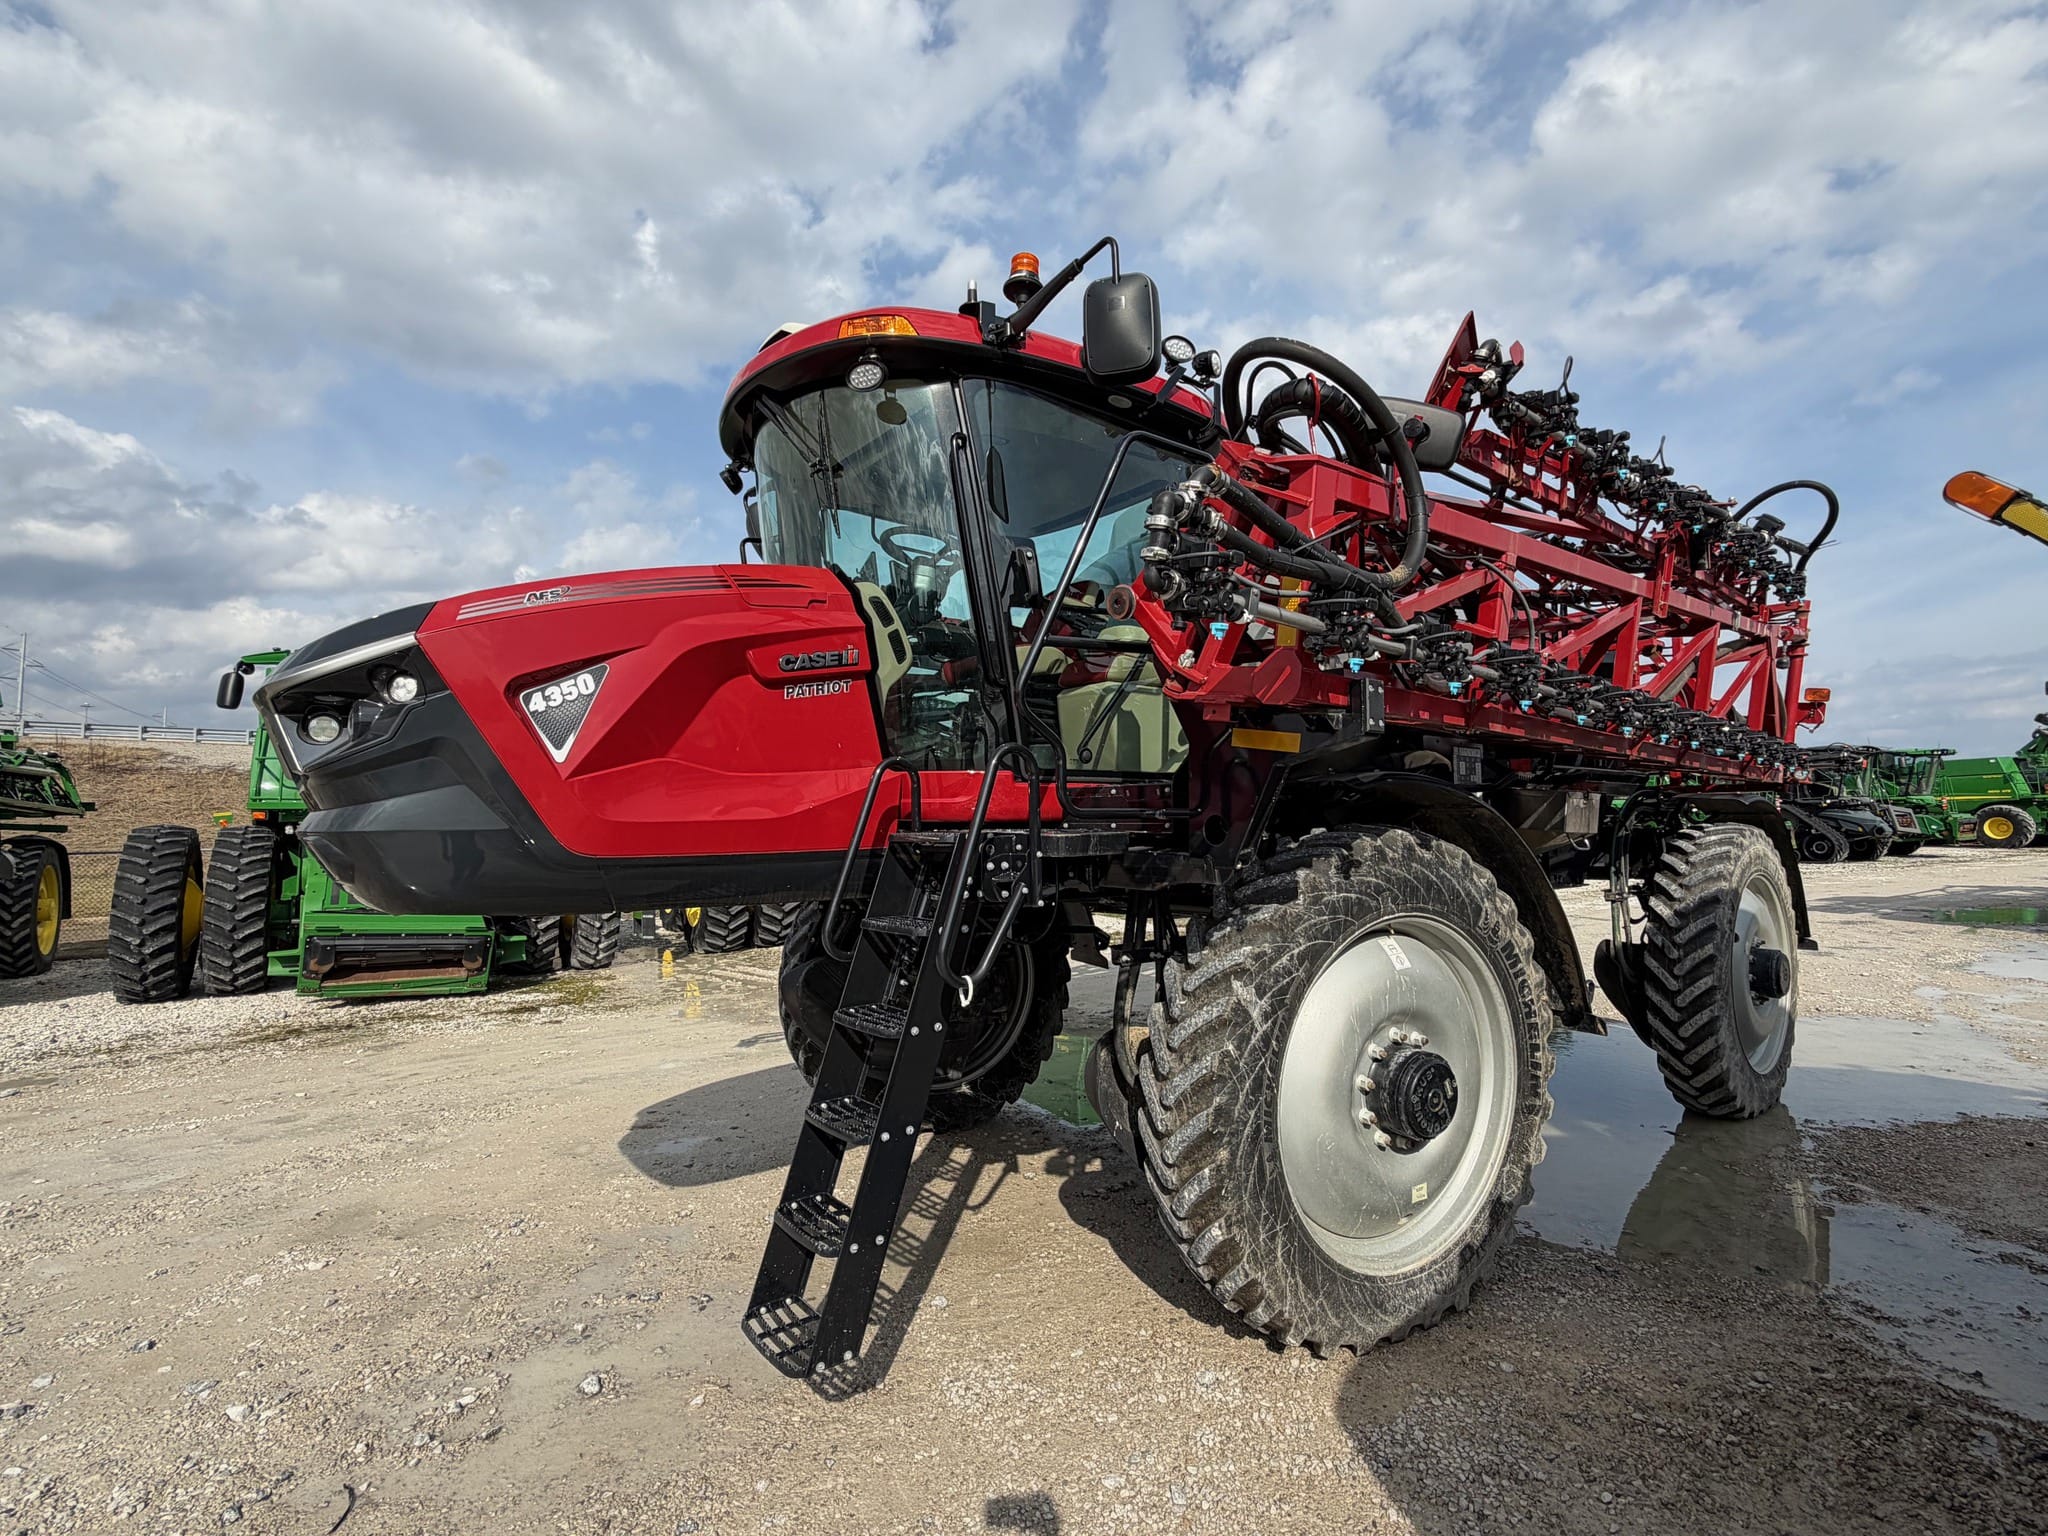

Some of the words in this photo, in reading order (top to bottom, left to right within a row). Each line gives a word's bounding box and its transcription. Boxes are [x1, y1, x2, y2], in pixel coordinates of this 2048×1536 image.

[524, 588, 562, 603] AFS
[779, 650, 840, 671] CASE
[528, 672, 596, 713] 4350
[783, 679, 852, 700] PATRIOT
[1500, 938, 1543, 1101] MICHELIN
